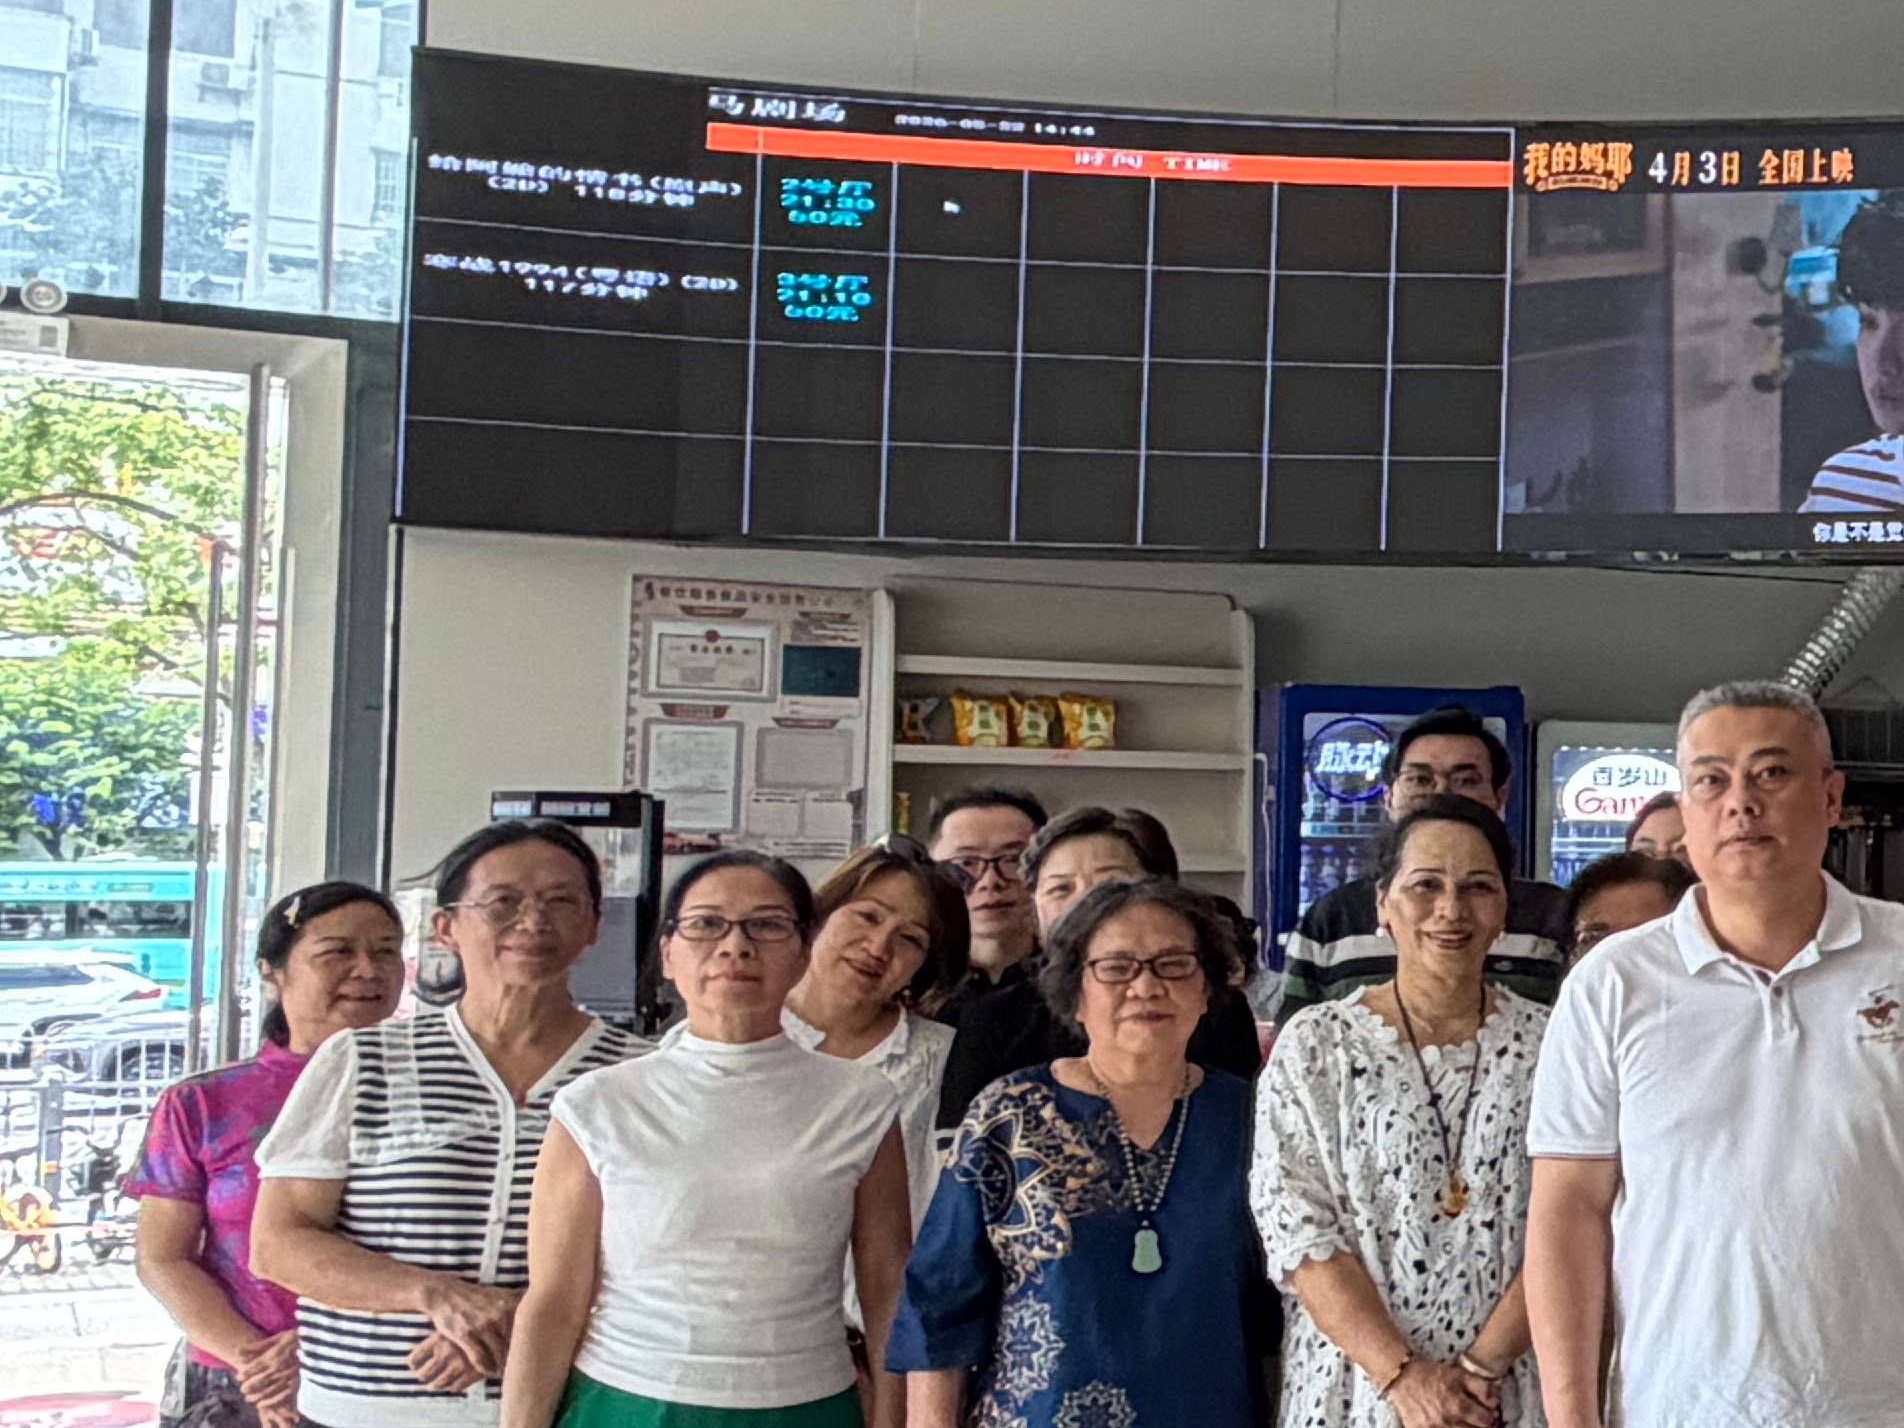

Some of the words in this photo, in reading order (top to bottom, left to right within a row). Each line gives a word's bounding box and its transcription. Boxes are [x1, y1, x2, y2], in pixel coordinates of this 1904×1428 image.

[1523, 141, 1633, 181] 我的妈耶
[1648, 150, 1741, 187] 4月3日
[1758, 147, 1855, 186] 全国上映
[1592, 766, 1667, 787] 百岁山
